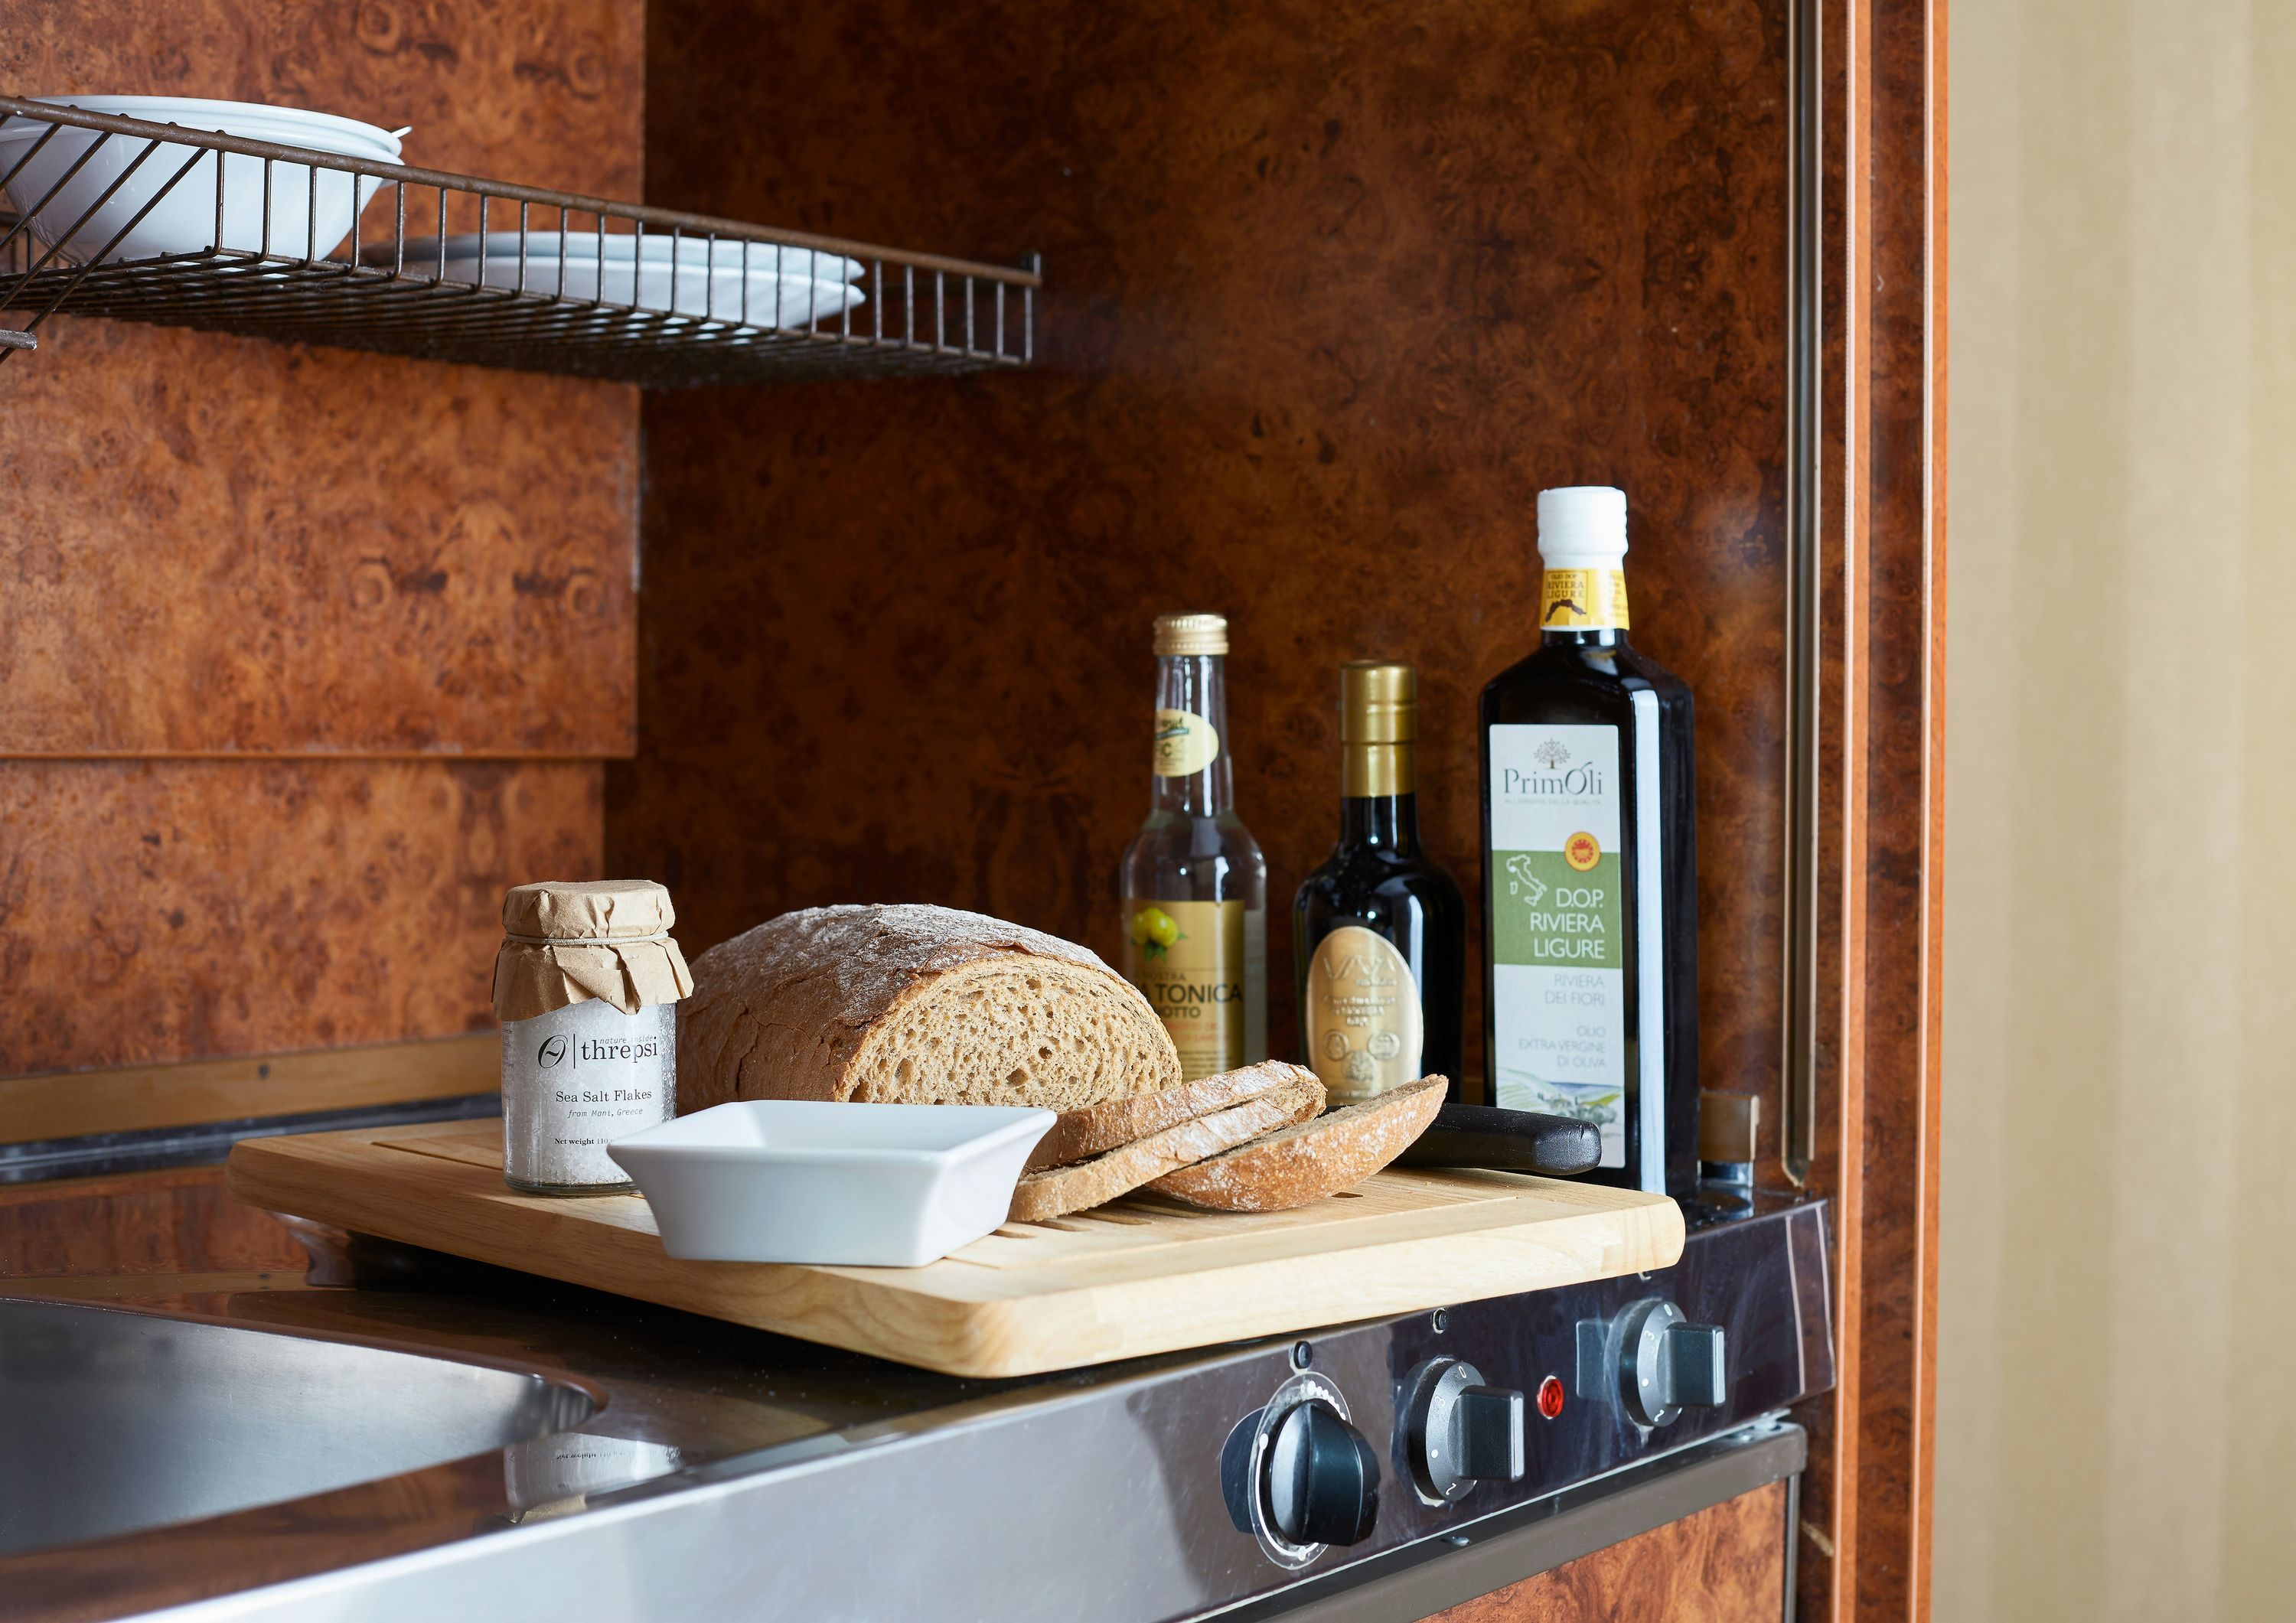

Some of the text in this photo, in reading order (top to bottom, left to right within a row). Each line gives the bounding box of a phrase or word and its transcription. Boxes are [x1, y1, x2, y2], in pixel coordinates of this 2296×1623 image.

[1530, 912, 1605, 933] RIVIERA
[1534, 938, 1605, 959] LIGURE
[1554, 973, 1605, 988] RIVIERA
[1155, 983, 1244, 1004] TONICA
[1544, 991, 1606, 1005] DEI FIORI
[1159, 1005, 1202, 1018] OTTO
[1576, 1025, 1606, 1038] OLIO
[581, 1036, 658, 1064] threpsi
[1518, 1038, 1606, 1054] EXTRA VERGINE
[1557, 1055, 1606, 1069] DI OLIVA
[556, 1089, 652, 1103] Sea Salt Flakes
[566, 1107, 643, 1119] from Mani, Greece
[569, 1138, 595, 1146] weight
